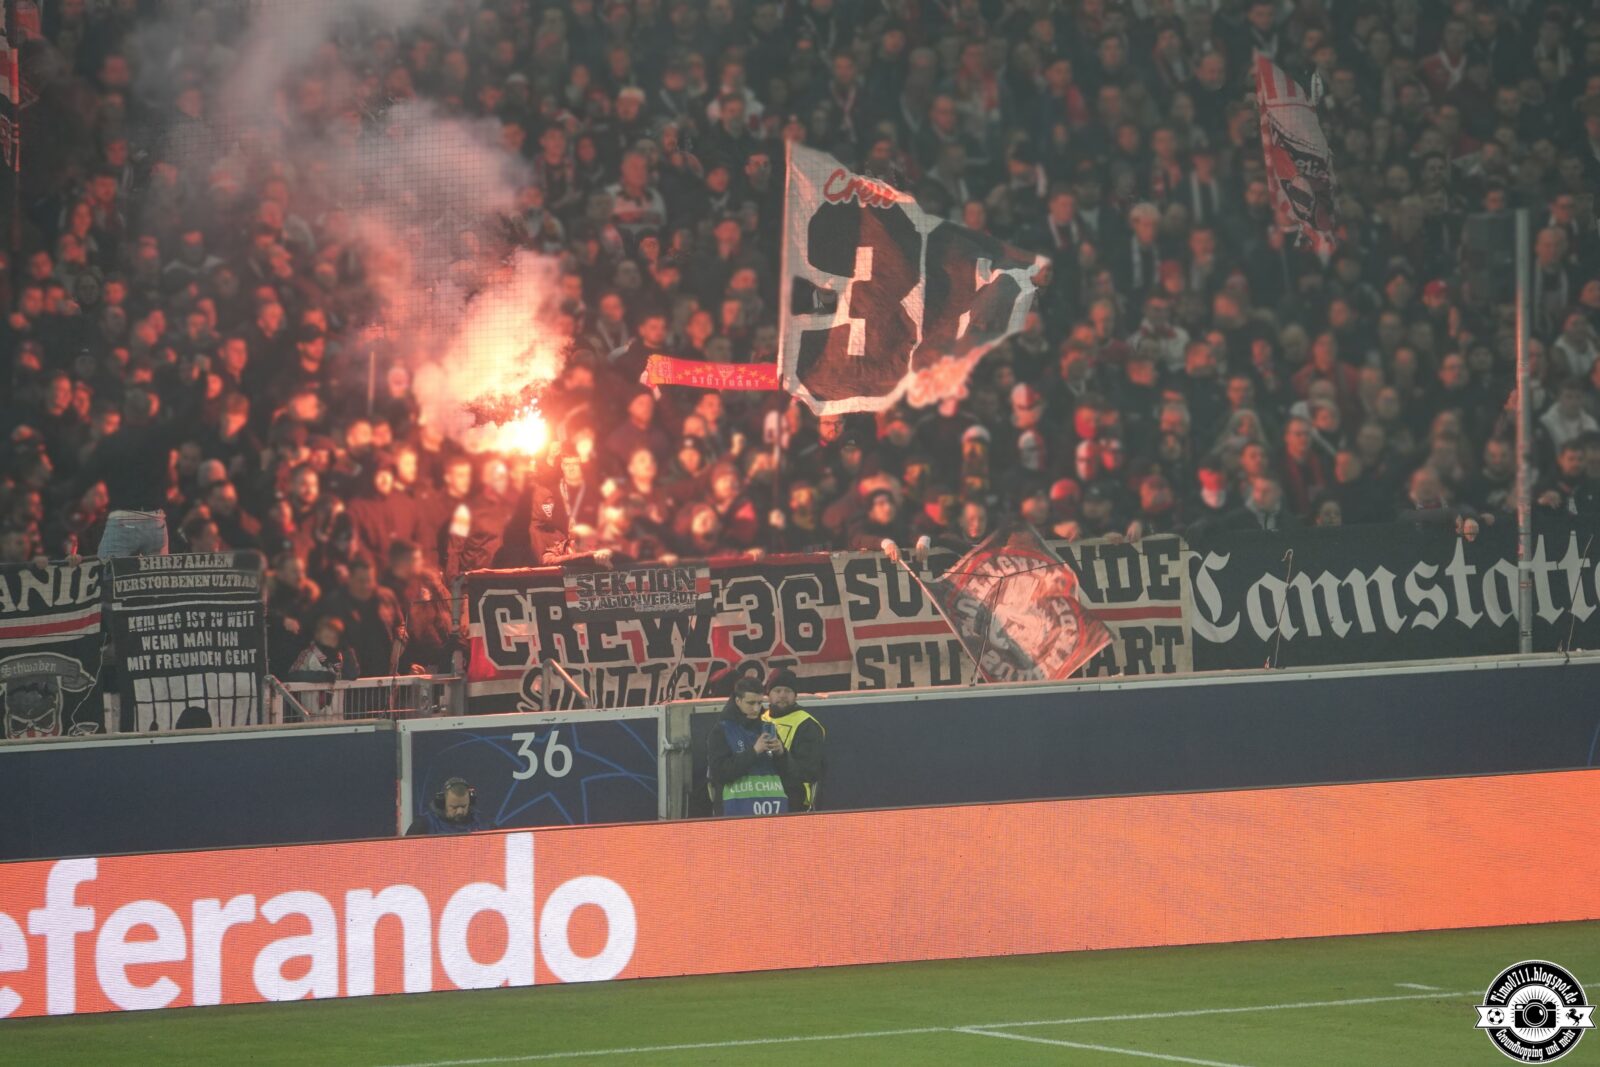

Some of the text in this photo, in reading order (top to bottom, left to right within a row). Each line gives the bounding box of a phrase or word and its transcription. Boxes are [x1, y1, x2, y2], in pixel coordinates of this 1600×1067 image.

[139, 552, 235, 572] EHRE ALLEN
[115, 573, 257, 593] VERSTORBENEN ULTRAS
[576, 567, 697, 598] SEKTION
[1188, 530, 1600, 644] Cannstatt
[128, 610, 255, 632] KEIN WEG IST ZU WEIT
[723, 573, 827, 657] 36
[141, 630, 239, 651] WENN MAN IHN
[1, 660, 57, 677] Schwaben
[127, 648, 257, 672] MIT FREUNDEN GEHT
[511, 730, 573, 780] 36
[753, 801, 781, 815] 007
